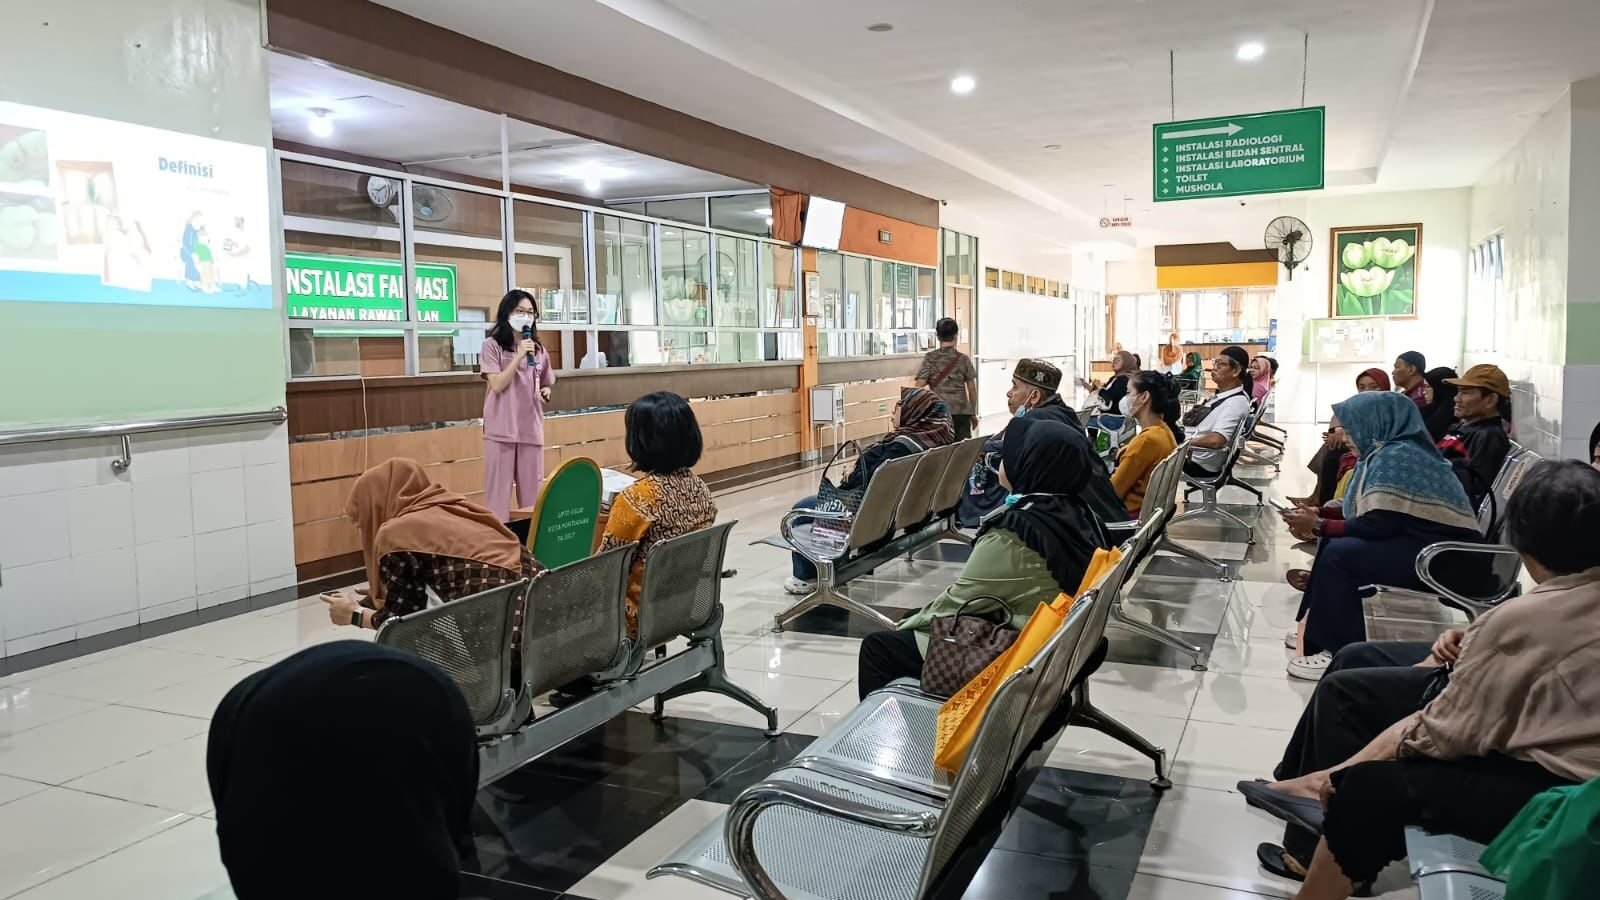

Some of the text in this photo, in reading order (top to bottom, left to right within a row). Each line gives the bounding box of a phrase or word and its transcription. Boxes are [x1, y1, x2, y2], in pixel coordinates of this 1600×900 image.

[1175, 134, 1283, 153] INSTALASI RADIOLOGI
[1175, 143, 1305, 163] INSTALASI BEDAH SENTRAL
[158, 156, 214, 178] Definisi
[1175, 154, 1305, 173] INSTALASI LABORATORIUM
[1175, 173, 1208, 183] TOILET
[1175, 182, 1224, 194] MUSHOLA
[286, 267, 449, 301] NSTALASI FAMASI
[359, 308, 403, 321] RAWAT
